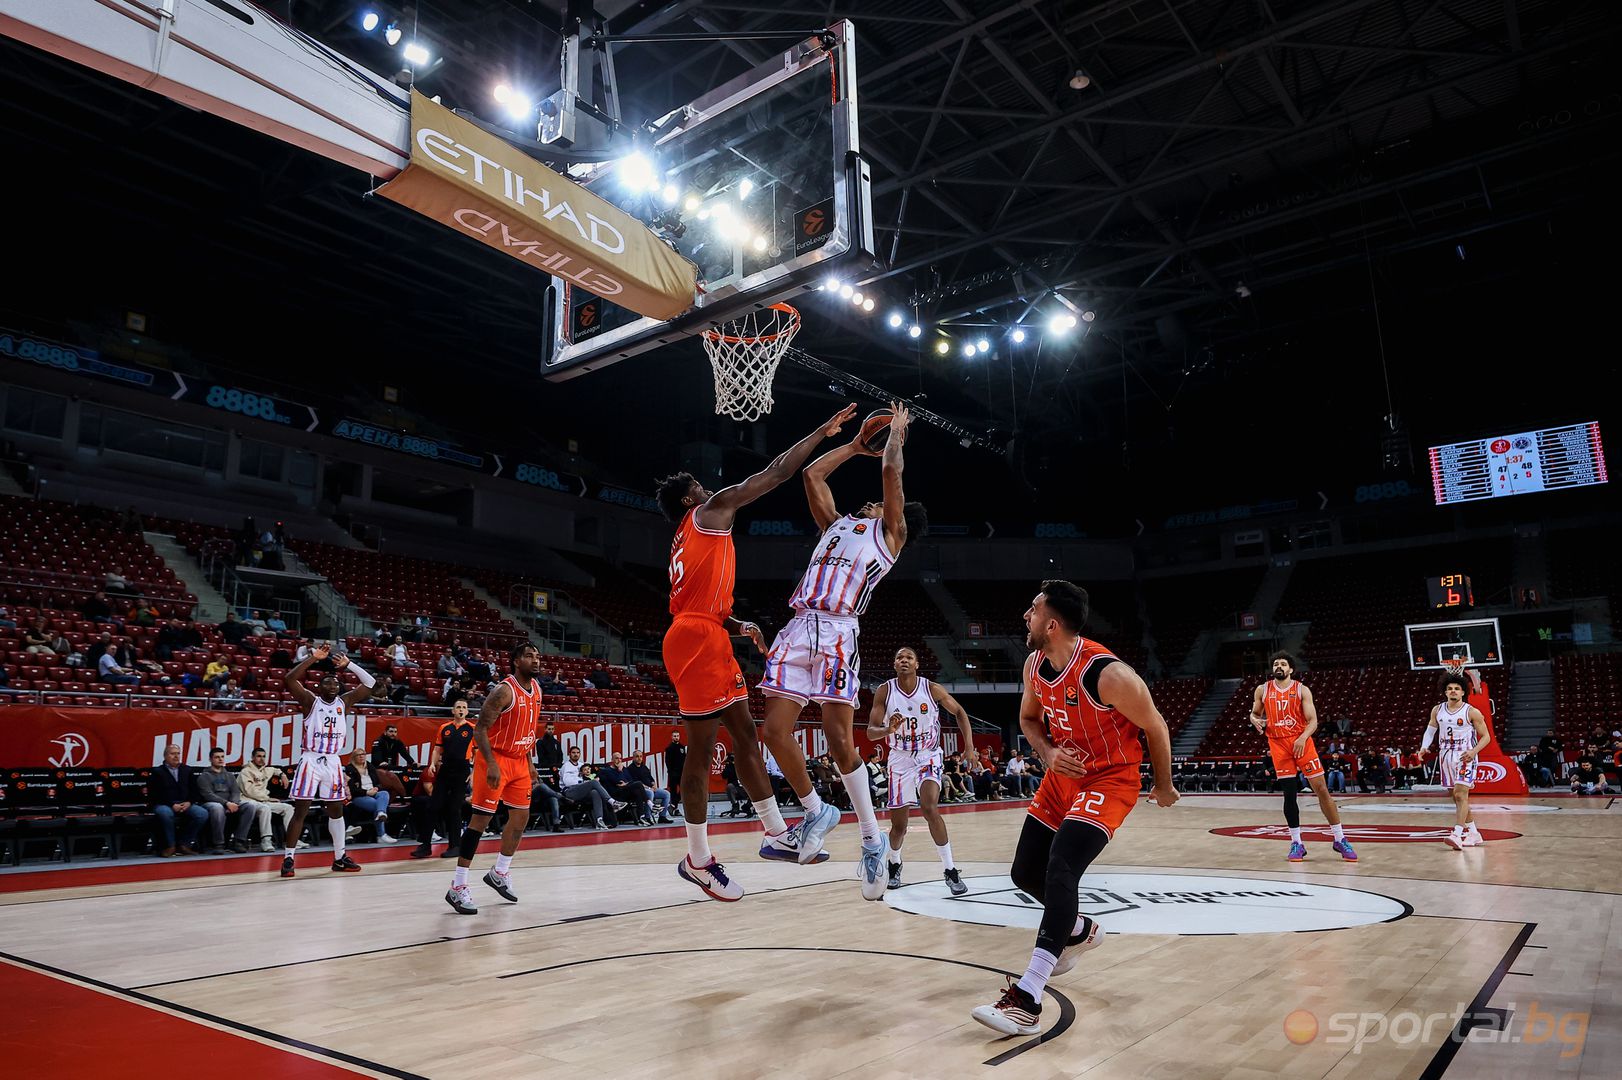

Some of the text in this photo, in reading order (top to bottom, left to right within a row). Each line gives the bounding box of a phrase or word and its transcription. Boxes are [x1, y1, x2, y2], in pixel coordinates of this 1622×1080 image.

[416, 128, 625, 254] ETIHAD
[453, 208, 624, 295] ETIHAD
[1506, 454, 1523, 464] 1:37
[1498, 465, 1507, 473] 47
[1521, 462, 1533, 470] 48
[826, 536, 841, 550] 8
[1441, 574, 1462, 587] 1:37
[834, 669, 847, 690] 8
[1277, 700, 1288, 711] 17
[314, 716, 337, 728] 24
[528, 709, 533, 723] 1
[1043, 705, 1073, 731] 22
[1447, 727, 1453, 736] 2
[1310, 758, 1321, 770] 17
[1465, 769, 1471, 778] 2
[1070, 791, 1105, 815] 22
